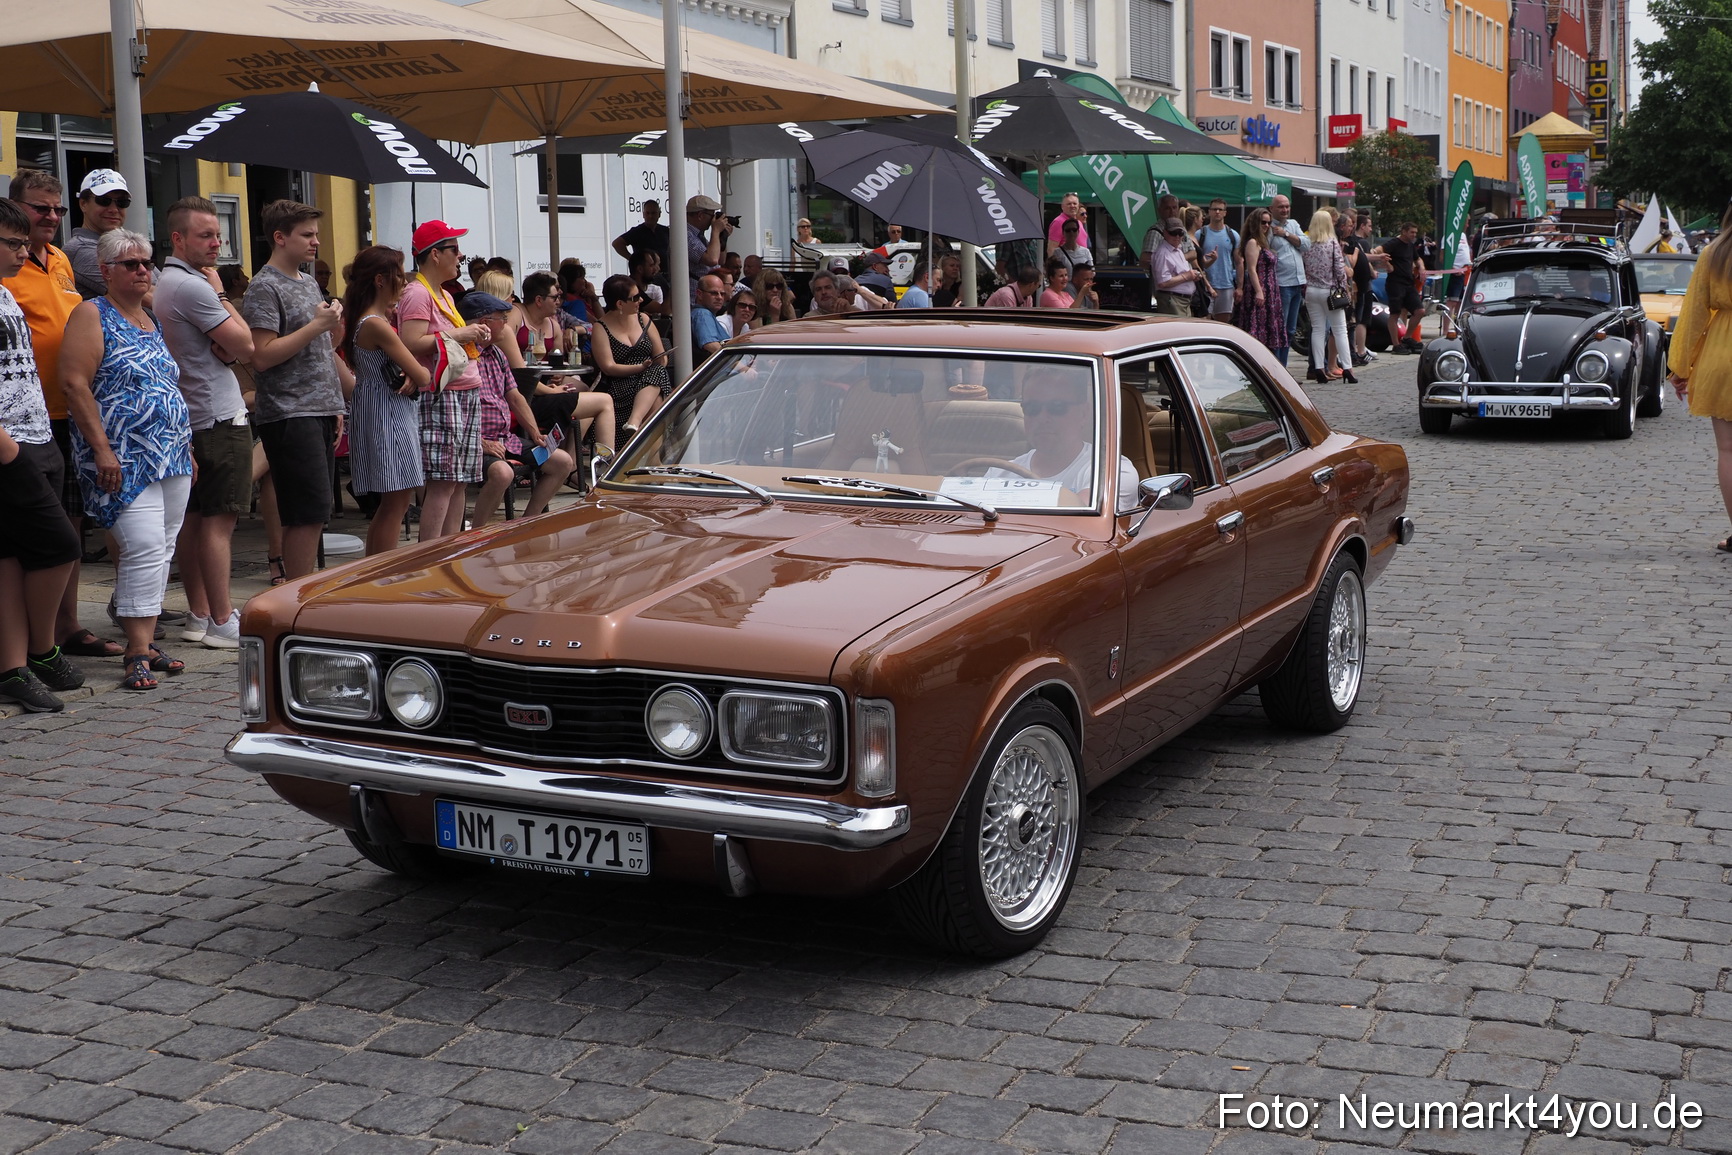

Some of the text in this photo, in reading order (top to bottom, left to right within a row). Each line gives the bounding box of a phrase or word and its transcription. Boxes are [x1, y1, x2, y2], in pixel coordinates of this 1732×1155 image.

[1589, 62, 1607, 160] HOTEL
[1332, 125, 1356, 134] WITT
[642, 170, 656, 190] 30
[1452, 179, 1471, 230] DEKRA
[1486, 404, 1494, 416] M
[488, 633, 582, 649] FORD
[508, 708, 547, 725] GXL
[457, 810, 623, 868] NM T 1971
[627, 831, 643, 843] 05
[502, 859, 576, 876] FREISTAAT BAYERN
[628, 858, 643, 869] 07
